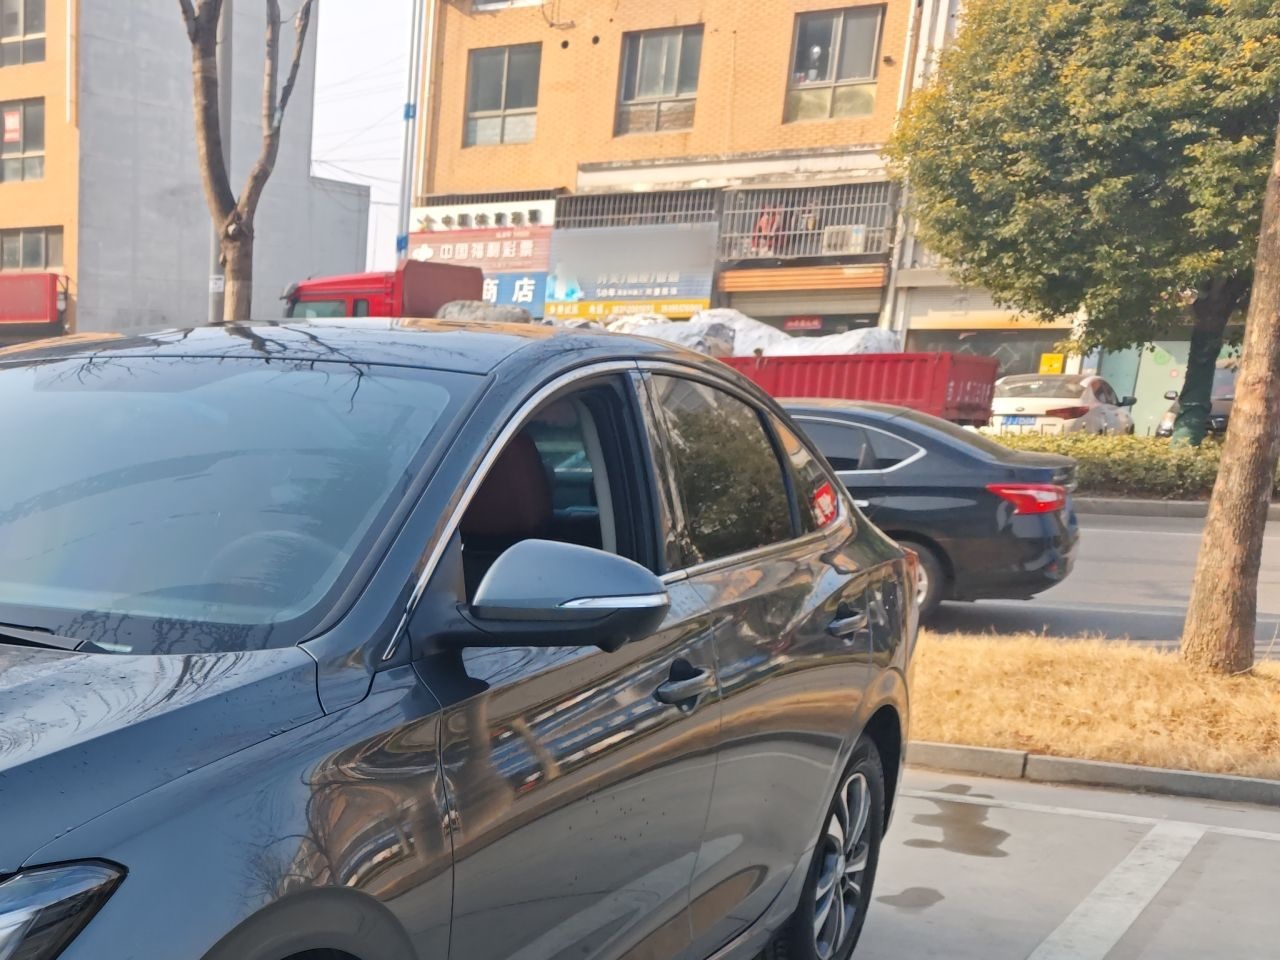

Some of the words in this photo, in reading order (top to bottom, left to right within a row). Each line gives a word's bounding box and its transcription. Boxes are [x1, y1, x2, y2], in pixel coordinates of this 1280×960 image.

[439, 239, 535, 260] 中国福利彩票
